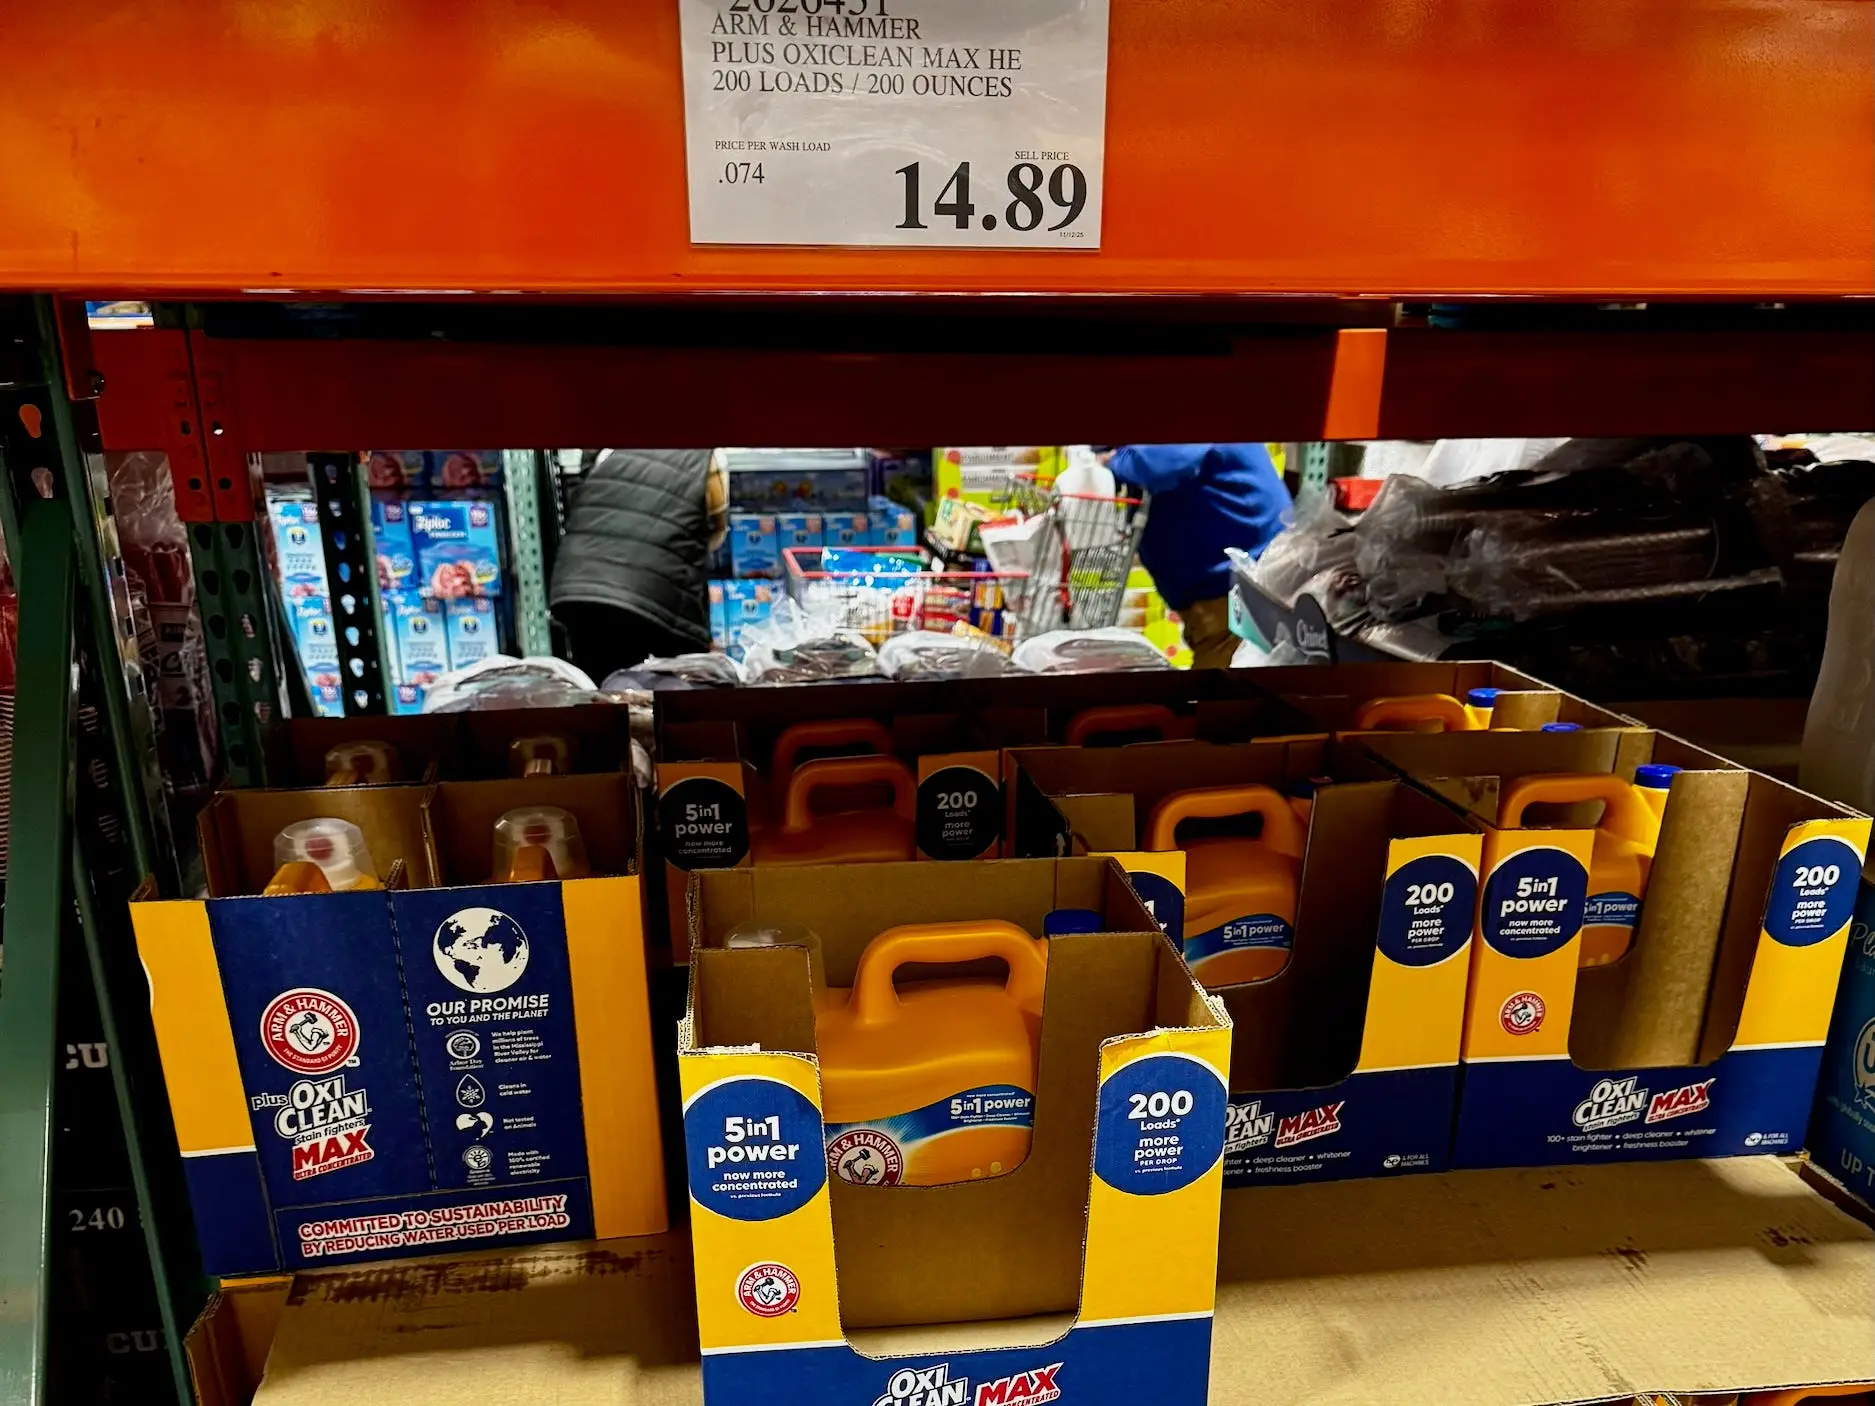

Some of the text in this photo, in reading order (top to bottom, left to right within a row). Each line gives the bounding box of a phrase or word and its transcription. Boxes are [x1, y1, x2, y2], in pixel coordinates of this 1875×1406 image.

[711, 13, 922, 40] ARM & HAMMER
[711, 41, 1022, 71] PLUS OXICLEAN MAX HE
[713, 69, 1013, 98] 200 LOADS / 200 OUNCES
[715, 140, 831, 152] PRICE PER WASH LOAD
[1014, 151, 1070, 161] SELL PRICE
[718, 161, 765, 184] .074
[895, 161, 1087, 232] 14.89
[685, 802, 721, 822] 5in1
[936, 791, 978, 810] 200
[674, 822, 734, 840] power
[941, 828, 974, 839] power
[944, 821, 971, 830] more
[1516, 876, 1559, 898] 5in1
[1792, 864, 1840, 888] 200
[1404, 882, 1455, 906] 200
[1796, 900, 1826, 909] more
[1500, 899, 1568, 918] power
[1603, 903, 1638, 914] power
[1791, 908, 1828, 920] power
[1223, 924, 1285, 939] 5in1 power
[1407, 927, 1445, 940] power
[1411, 918, 1442, 929] more
[1499, 925, 1561, 936] concentrated
[426, 994, 550, 1017] OUR PROMISE
[430, 1008, 549, 1026] TO YOU AND THE PLANET
[271, 998, 350, 1042] ARM & HAMMER
[251, 1075, 344, 1110] plus OXI
[1592, 1078, 1635, 1104] OXI
[1650, 1081, 1710, 1115] MAX
[277, 1091, 367, 1137] CLEAN
[950, 1097, 1031, 1115] 5in1 power
[1127, 1089, 1194, 1120] 200
[1573, 1090, 1646, 1125] CLEAN
[295, 1117, 366, 1145] stain fighters
[724, 1115, 780, 1143] 5in1
[1278, 1101, 1342, 1138] MAX
[1139, 1135, 1180, 1148] more
[1566, 1133, 1586, 1142] stain
[1586, 1132, 1613, 1143] fighter
[1622, 1132, 1643, 1141] deep
[1644, 1130, 1673, 1139] cleaner
[1684, 1128, 1717, 1138] whitener
[1572, 1138, 1689, 1152] brightener freshness booster
[293, 1128, 369, 1172] MAX
[707, 1144, 800, 1169] power
[829, 1133, 899, 1172] RM & HAMMER
[1134, 1145, 1184, 1162] power
[1155, 1157, 1178, 1165] DROP
[1253, 1156, 1275, 1165] deep
[1276, 1154, 1306, 1163] cleaner
[1317, 1150, 1352, 1160] whitener
[1841, 1147, 1863, 1174] UP
[294, 1152, 372, 1179] ULTRA CONCENTRATED
[723, 1170, 786, 1181] now more
[1255, 1165, 1292, 1174] freshness
[1293, 1163, 1323, 1173] booster
[711, 1178, 798, 1192] concentrated
[68, 1206, 125, 1231] 240
[299, 1195, 568, 1239] COMMITTED TO SUSTAINABILITY
[302, 1212, 570, 1257] BY REDUCING WATER USED PER LOAD
[743, 1267, 797, 1297] ARM & HAMMER
[889, 1364, 947, 1400] OXI
[978, 1365, 1061, 1406] MAX
